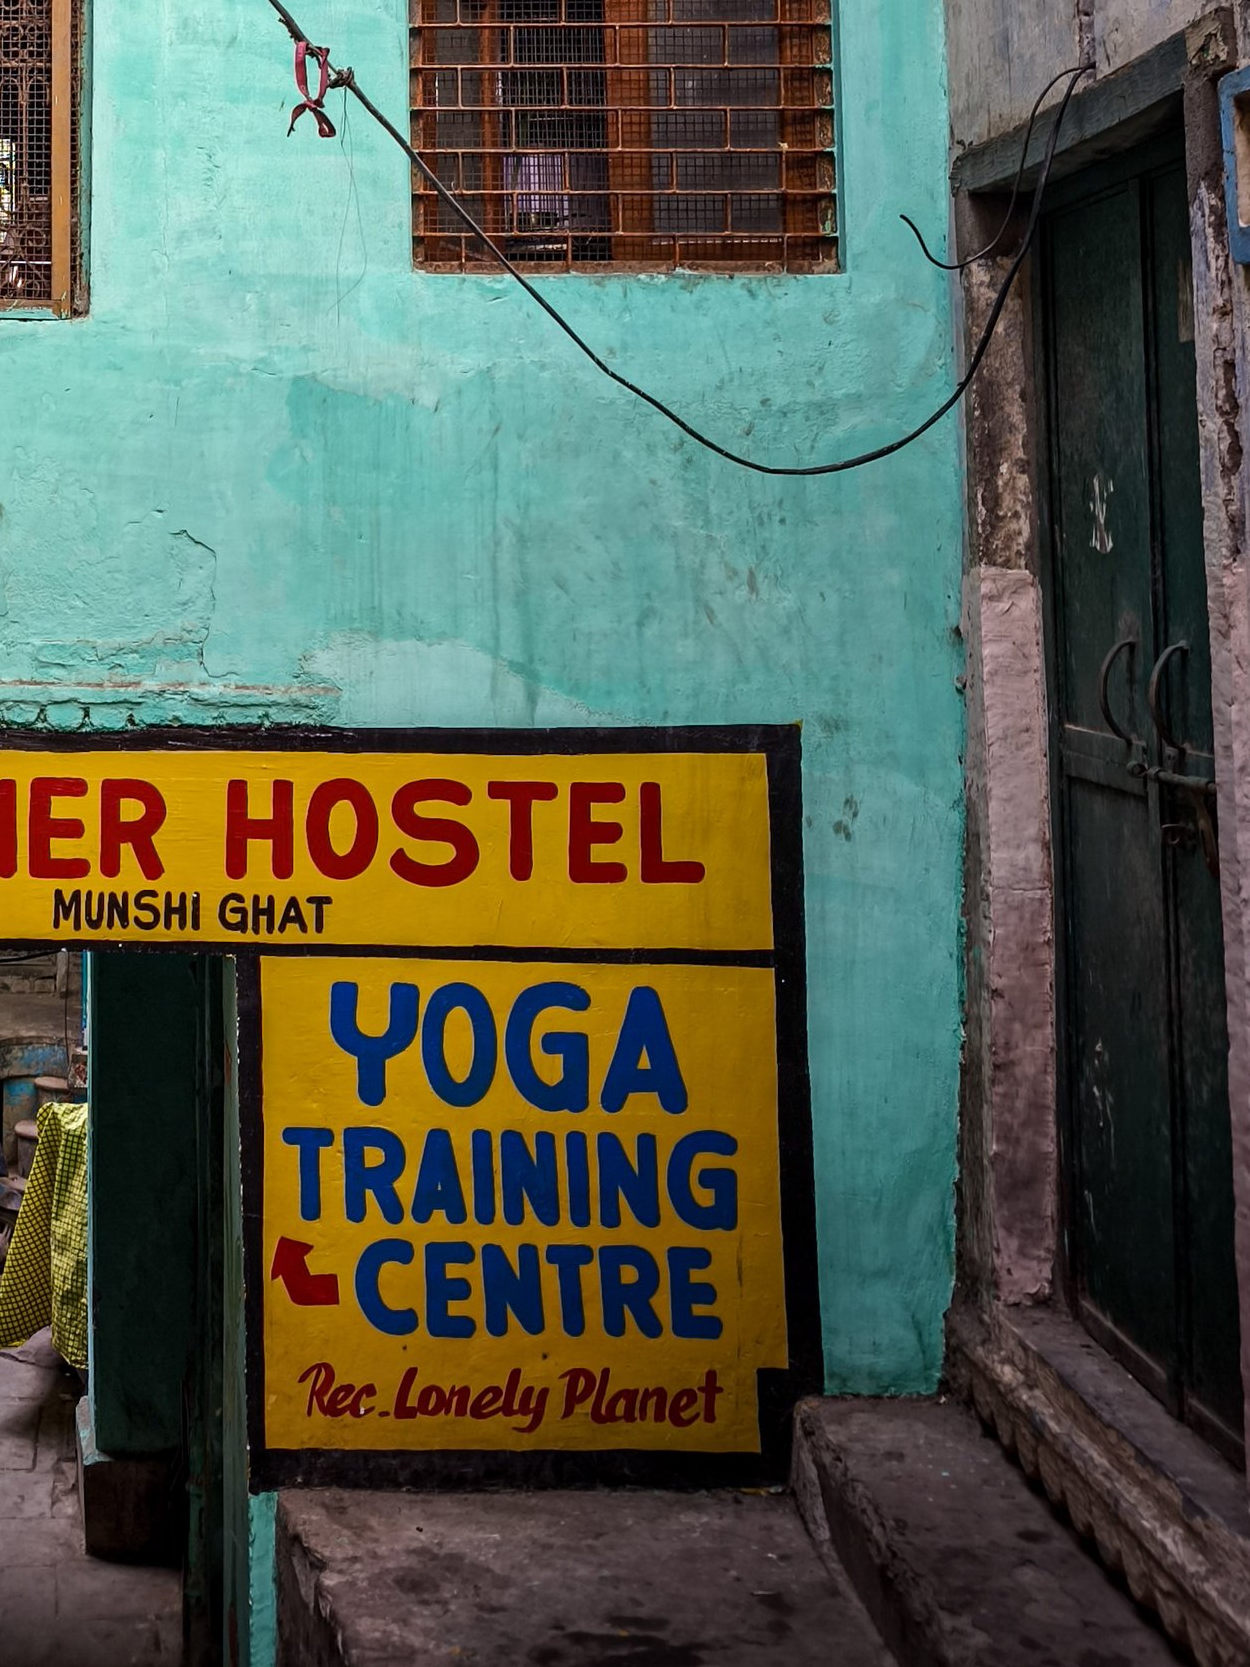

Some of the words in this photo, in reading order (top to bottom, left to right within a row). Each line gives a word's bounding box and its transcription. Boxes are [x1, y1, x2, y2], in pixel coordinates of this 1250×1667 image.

[224, 777, 707, 887] HOSTEL
[53, 888, 201, 931] MUNSHI
[218, 892, 333, 935] GHAT
[330, 982, 687, 1114] YOGA
[282, 1127, 737, 1231] TRAINING
[355, 1239, 723, 1340] CENTRE
[297, 1361, 390, 1419] Rec.
[394, 1366, 550, 1434] Lonely
[557, 1366, 725, 1428] Planet
